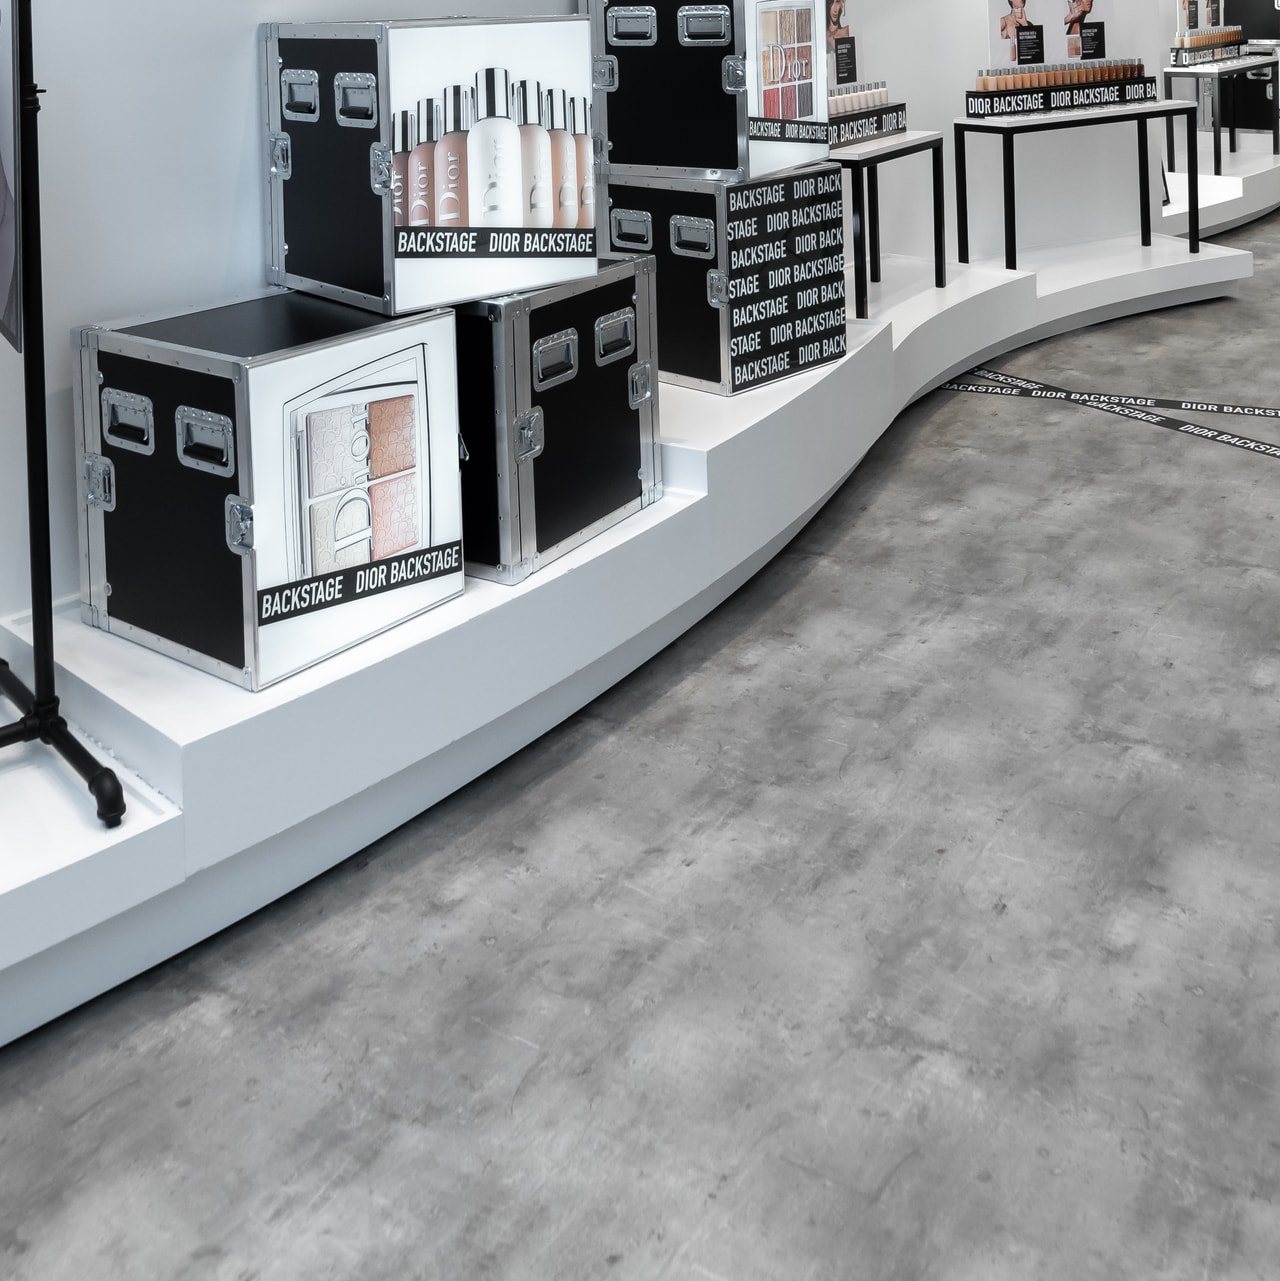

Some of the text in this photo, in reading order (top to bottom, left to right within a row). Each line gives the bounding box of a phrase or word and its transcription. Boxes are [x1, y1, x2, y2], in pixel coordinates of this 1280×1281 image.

[768, 44, 808, 83] Dior
[968, 93, 1044, 114] DIOR BACKSTAGE
[1051, 86, 1119, 108] DIOR BACKSTAGE
[1126, 83, 1145, 100] DIOR
[749, 120, 827, 140] BACKSTAGE DIOR BACKSTAGE
[840, 116, 878, 143] BACKSTAGE
[882, 113, 897, 131] DIOR
[410, 161, 429, 227] Dior
[439, 151, 461, 223] Dior
[729, 173, 841, 211] BACKSTAGE DIOR BACK
[727, 200, 842, 241] STAGE DIOR BACKSTAGE
[398, 232, 593, 253] BACKSTAGE DIOR BACKSTAGE
[731, 307, 846, 357] STAGE DIOR BACKSTAGE
[735, 333, 846, 385] BACKSTAGE DIOR BACK
[1031, 389, 1066, 399] DIOR
[1070, 392, 1156, 406] BACKSTAGE
[1181, 402, 1218, 412] DIOR
[1178, 424, 1214, 438] DIOR
[333, 403, 374, 563] Dior
[262, 546, 460, 619] BACKSTAGE DIOR BACKSTAGE
